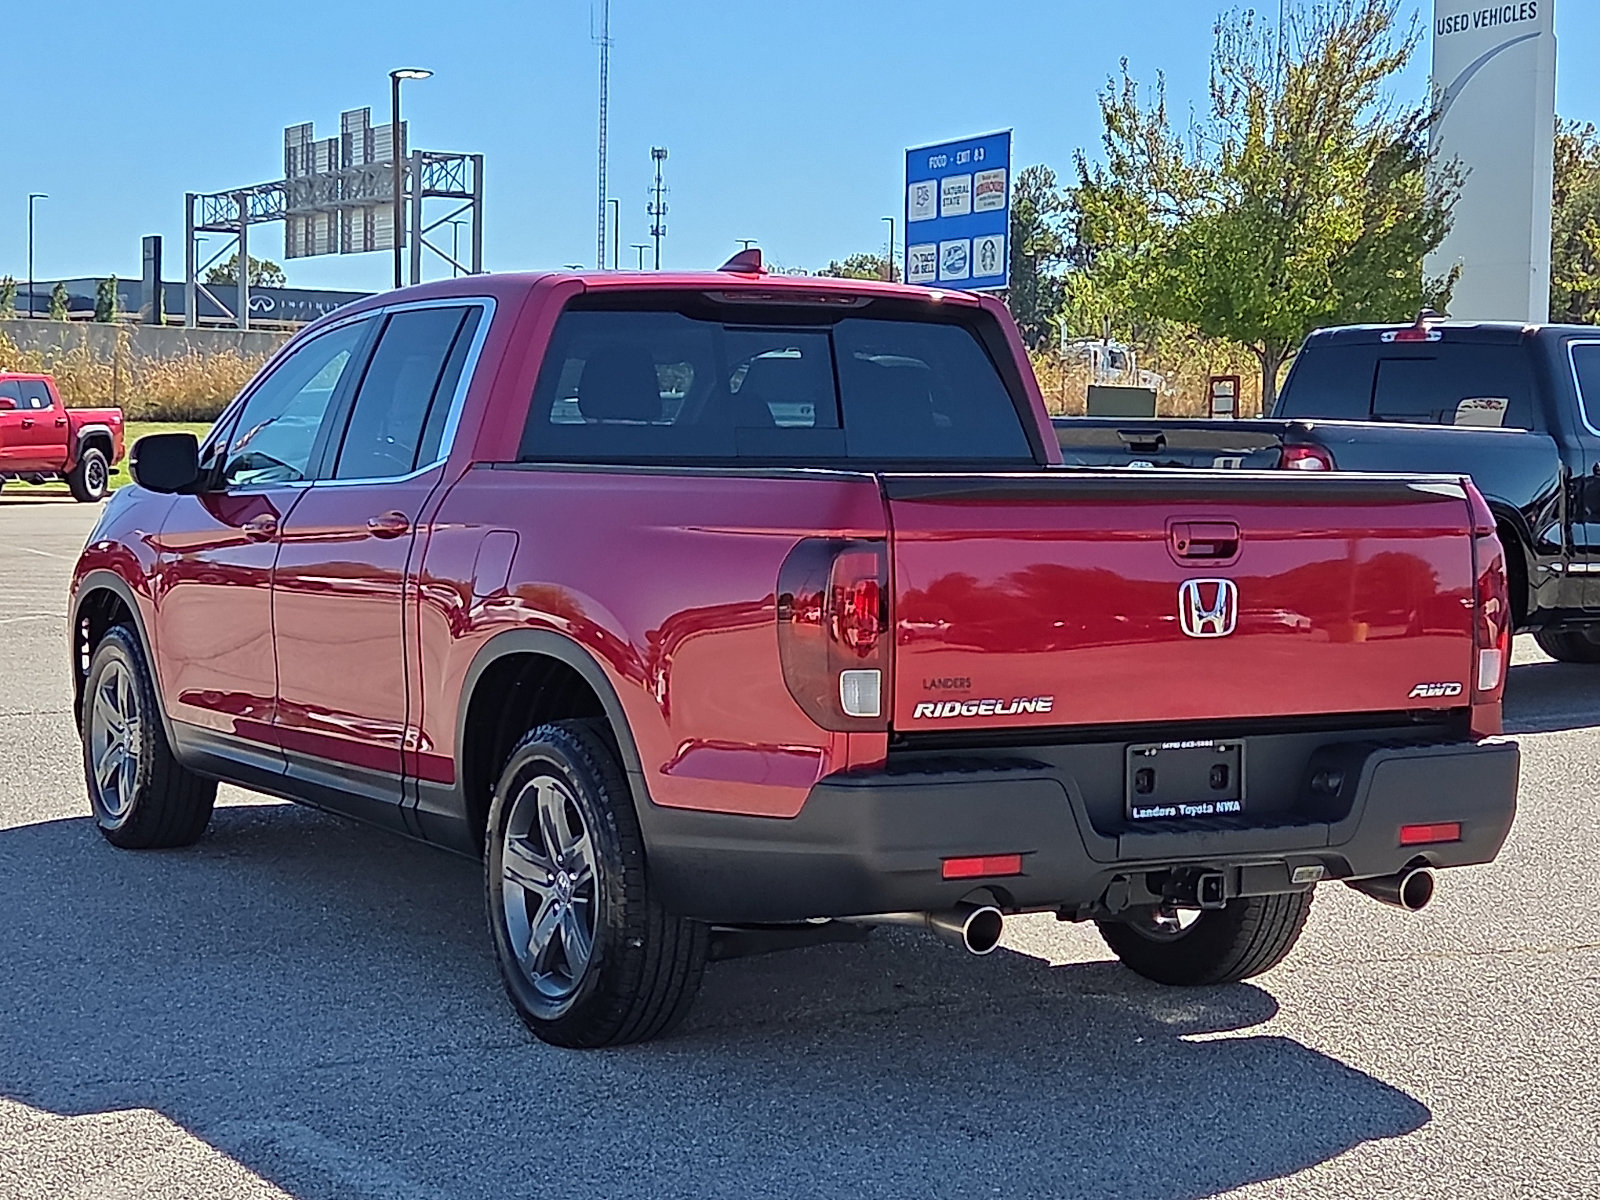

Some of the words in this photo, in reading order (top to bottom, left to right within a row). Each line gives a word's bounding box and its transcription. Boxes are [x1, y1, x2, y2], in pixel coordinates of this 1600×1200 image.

[1437, 14, 1469, 36] USED
[1472, 1, 1537, 29] VEHICLES
[928, 154, 948, 169] FOOD
[956, 149, 971, 165] EXIT
[943, 184, 970, 196] NATURAL
[942, 196, 961, 208] STATE
[919, 252, 935, 263] TACO
[920, 262, 935, 274] BELL
[280, 300, 340, 311] INFINIT
[922, 677, 972, 691] LANDERS
[1408, 682, 1462, 698] AWD
[912, 695, 1054, 719] RIDGELINE
[1132, 806, 1176, 819] Landers
[1178, 803, 1214, 817] Toyota
[1216, 800, 1241, 813] NWA
